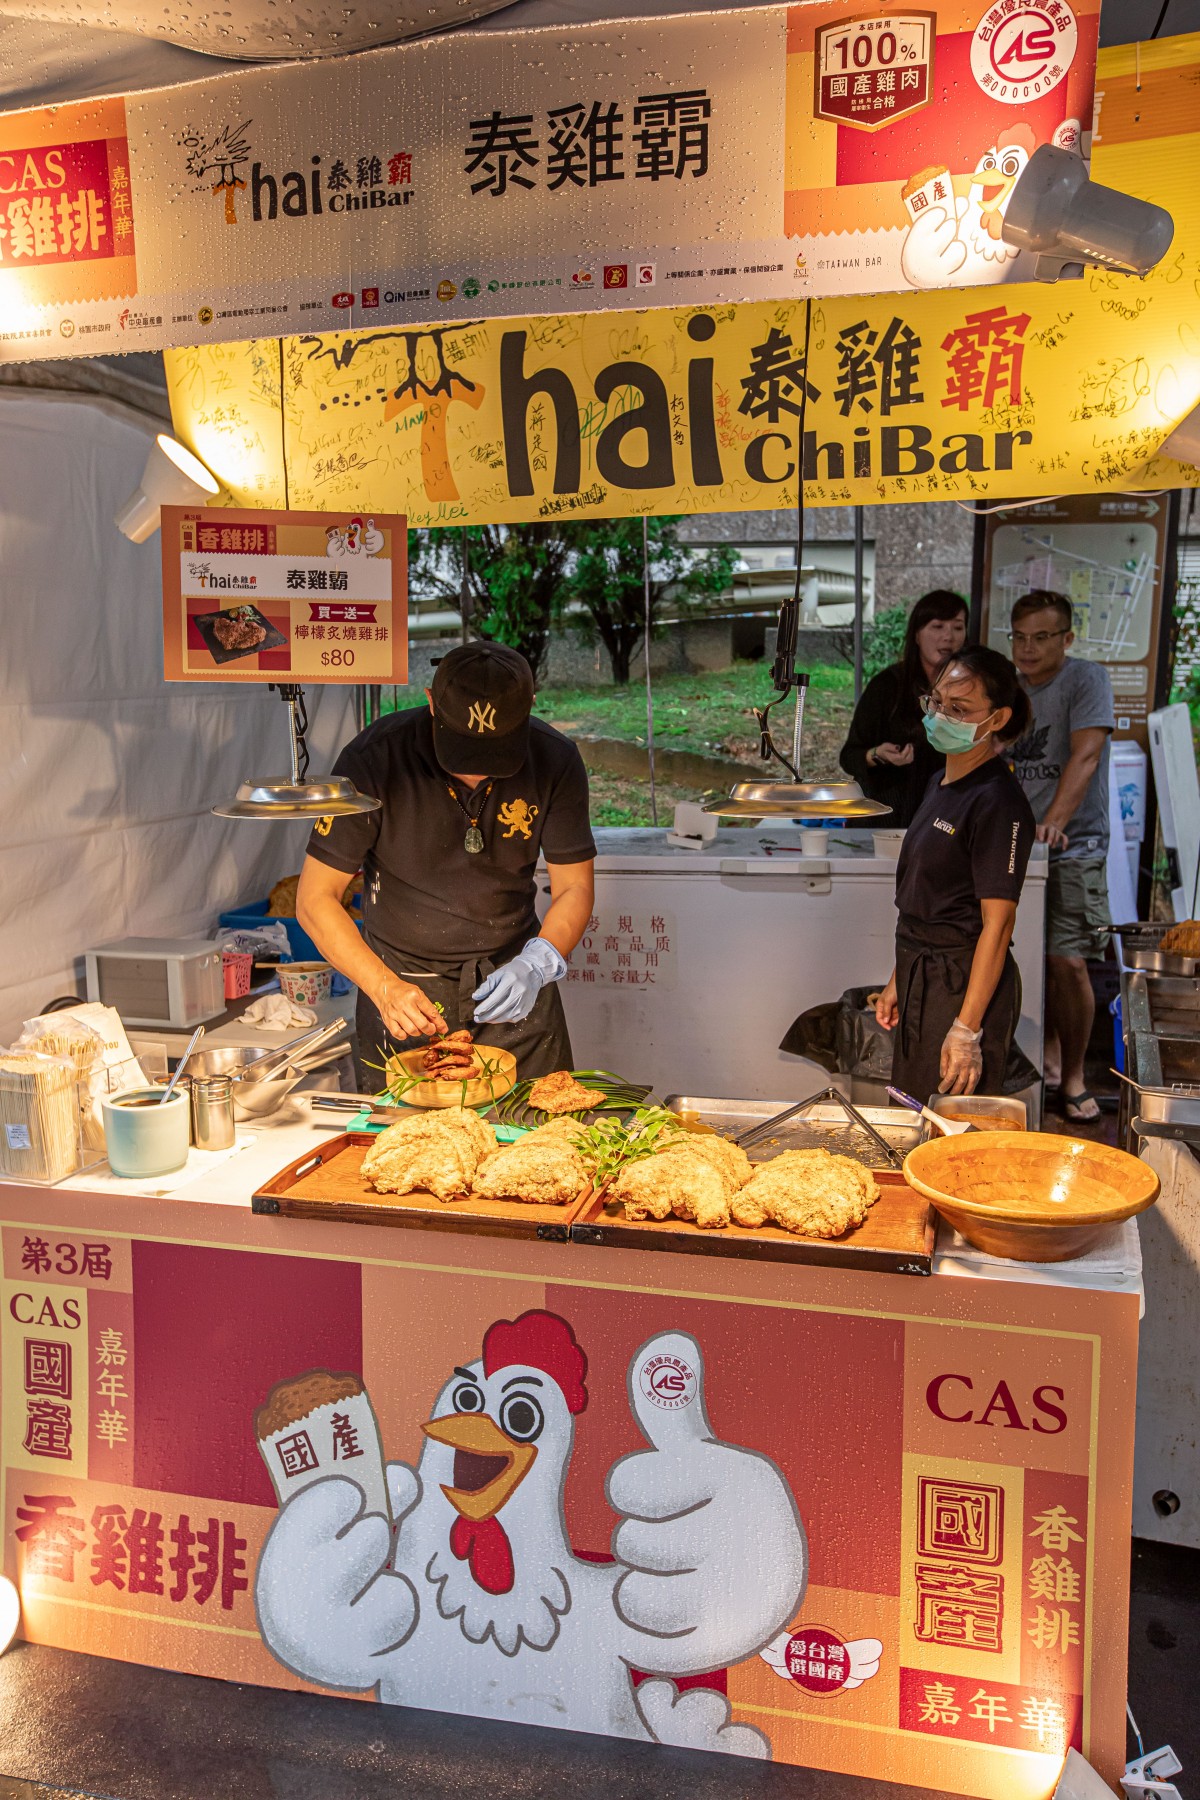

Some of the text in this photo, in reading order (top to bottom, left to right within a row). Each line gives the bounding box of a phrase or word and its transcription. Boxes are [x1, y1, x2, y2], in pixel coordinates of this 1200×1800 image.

[859, 20, 891, 31] 本店採用
[830, 68, 919, 98] 國產雞肉
[980, 65, 1064, 98] 第000000號
[873, 95, 895, 109] 合格
[464, 89, 711, 197] 泰雞霸
[326, 152, 413, 190] 泰雞霸
[111, 166, 133, 239] 嘉年華
[329, 188, 414, 213] ChiBar
[911, 180, 946, 212] 國產
[826, 257, 882, 269] TAIWAN BAR
[737, 304, 1032, 423] 泰雞霸
[669, 394, 689, 445] 柯文哲
[744, 424, 1033, 484] ChiBar
[199, 527, 265, 551] 香雞排
[286, 569, 348, 591] 泰雞霸
[318, 606, 370, 619] 買一送一
[295, 625, 389, 641] 檸檬炙燒雞排
[321, 649, 355, 667] $80
[104, 1041, 119, 1050] YOU
[21, 1236, 113, 1281] 第3屆
[9, 1293, 82, 1331] CAS
[22, 1336, 73, 1460] 國產
[95, 1327, 129, 1449] 嘉年華
[926, 1373, 1068, 1435] CAS
[275, 1412, 364, 1479] 國產
[15, 1494, 249, 1611] 香雞排
[914, 1475, 1006, 1654] 國產
[1027, 1505, 1085, 1655] 香雞排
[789, 1640, 845, 1662] 愛台灣
[789, 1657, 845, 1681] 選國產
[916, 1681, 1067, 1742] 嘉年華
